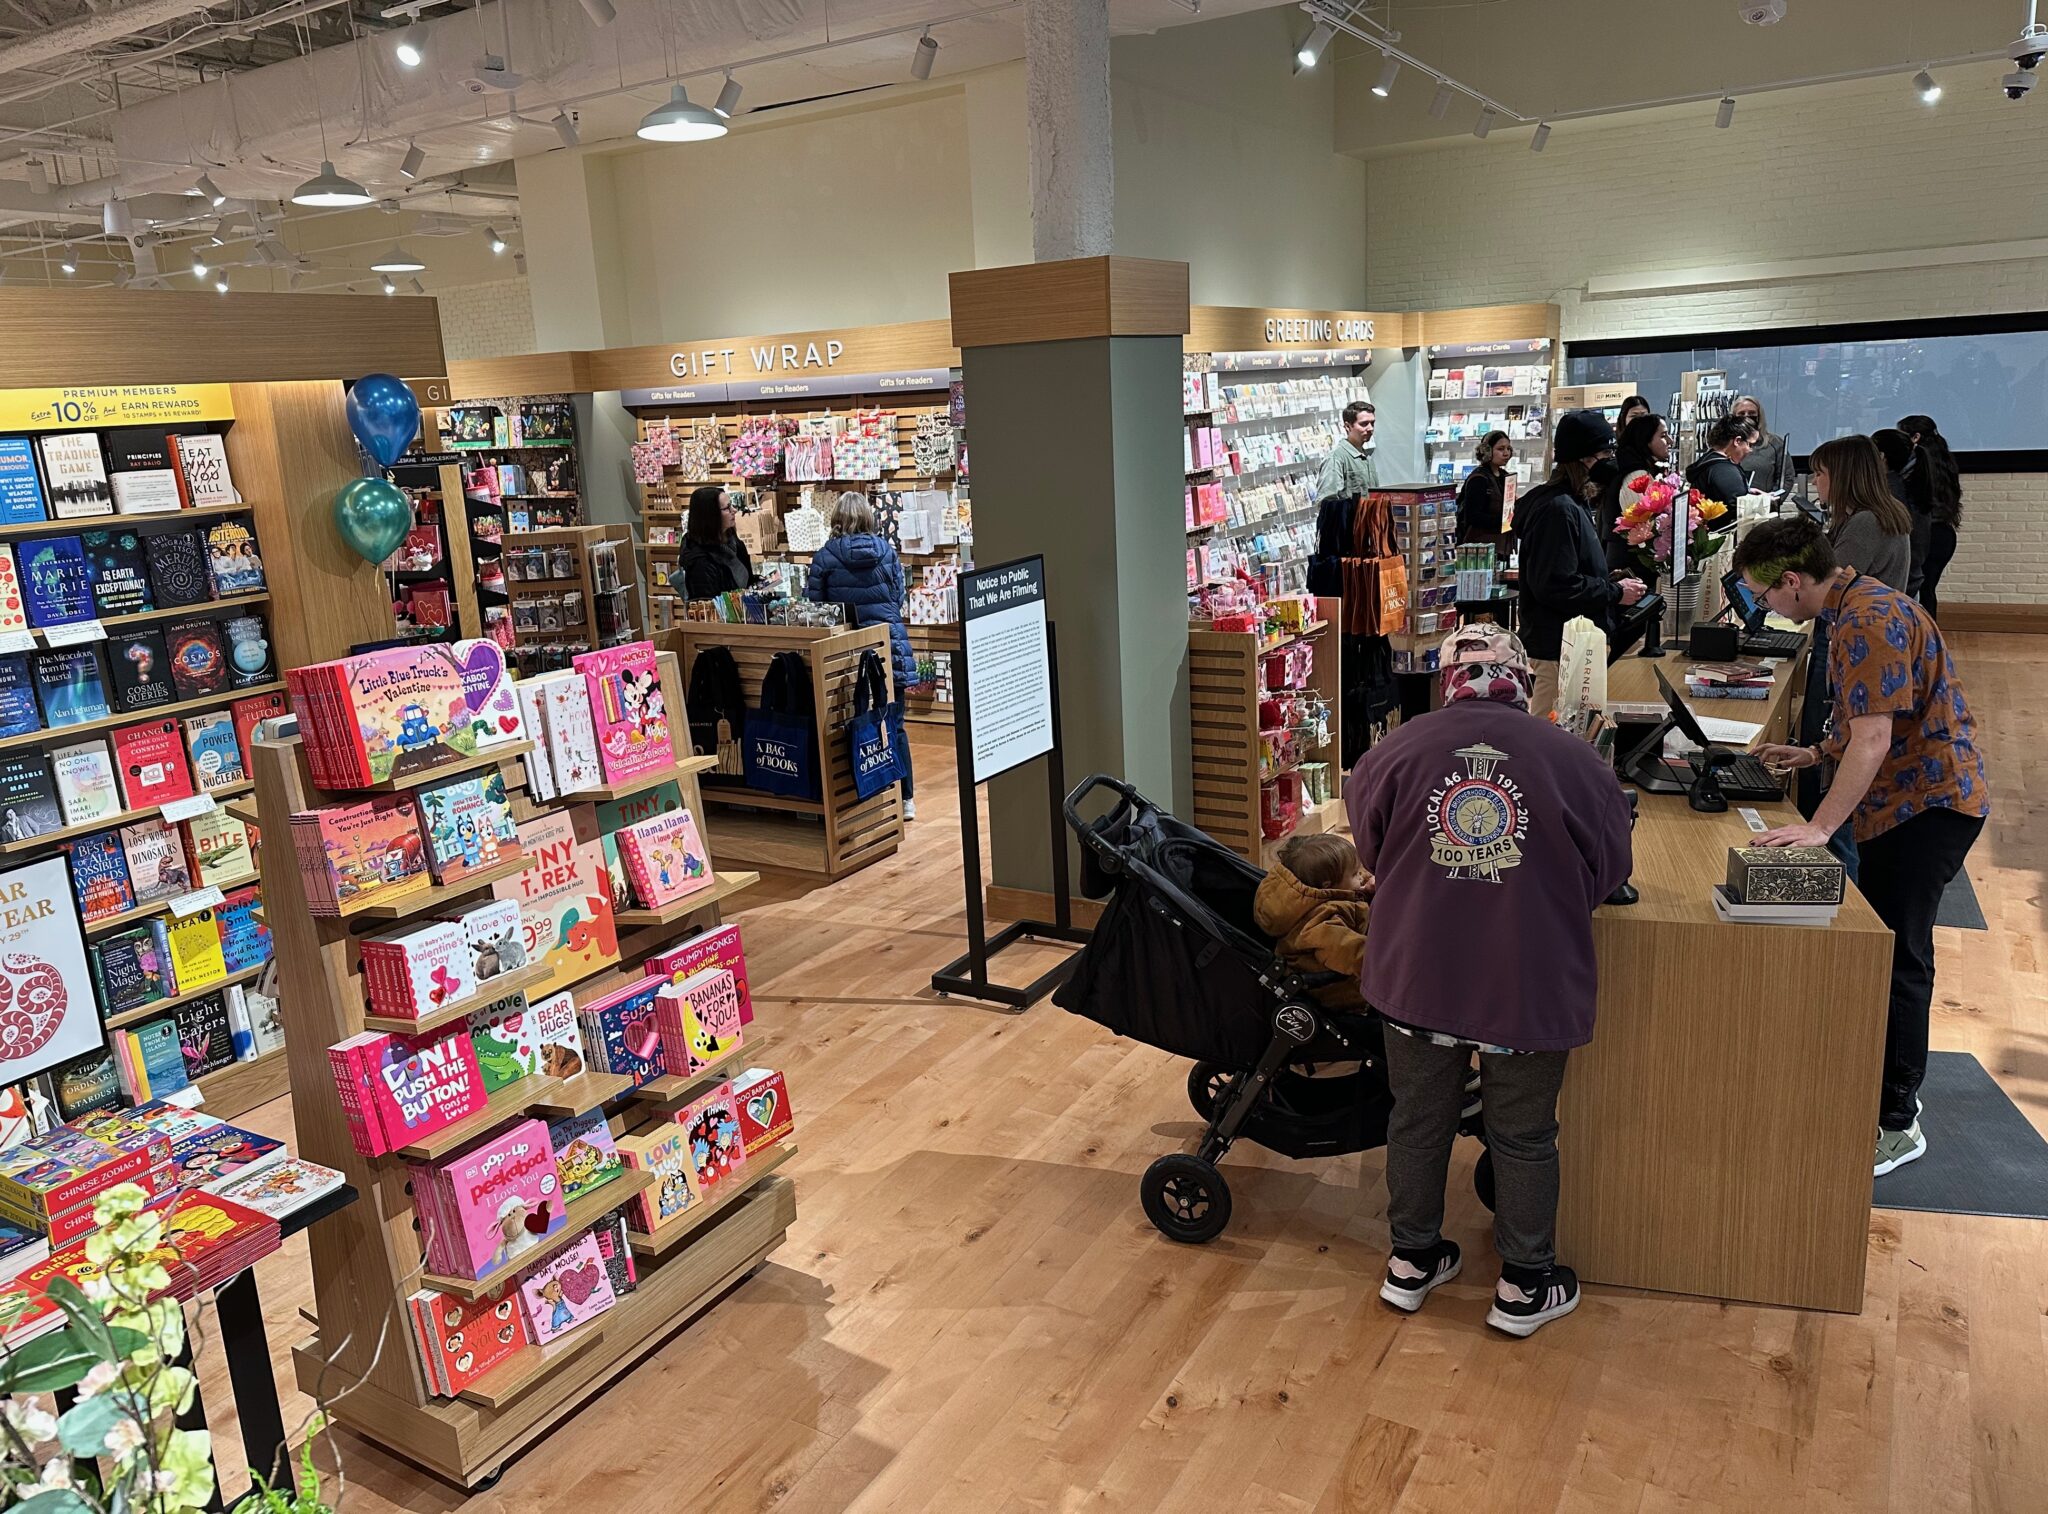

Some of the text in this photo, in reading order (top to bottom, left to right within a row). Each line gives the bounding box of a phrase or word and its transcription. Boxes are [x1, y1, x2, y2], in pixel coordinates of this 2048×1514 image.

[1265, 318, 1375, 343] GREETING CARDS
[1466, 344, 1511, 354] Greeting Cards
[670, 340, 843, 377] GIFT WRAP
[760, 383, 809, 395] Gifts for Readers
[880, 375, 933, 387] Gifts for Readers
[63, 386, 177, 398] PREMIUM MEMBERS
[651, 390, 696, 400] Gifts Readers
[31, 409, 52, 420] Extra
[121, 402, 149, 410] EARN
[152, 399, 200, 409] REWARDS
[84, 414, 99, 422] OFF
[60, 437, 83, 448] THE
[47, 448, 100, 462] TRADING
[126, 453, 162, 461] PRINCIPLES
[188, 447, 212, 458] EAT
[60, 462, 94, 475] GAME
[186, 458, 222, 470] WHAT
[191, 471, 220, 482] YOU
[193, 483, 223, 494] KILL
[31, 565, 85, 582] MARIE
[103, 567, 135, 581] IS EARTH
[976, 568, 1030, 592] Notice to Public
[34, 580, 89, 596] CURIE
[95, 578, 146, 595] EXCEPTIONAL?
[969, 581, 1038, 610] That We Are Filming
[54, 650, 93, 663] Miraculous
[174, 649, 221, 665] COSMOS
[621, 649, 651, 664] MICKEY
[358, 663, 449, 694] Little Blue Truck's
[126, 689, 169, 704] QUERIES
[127, 682, 165, 696] COSMIC
[383, 682, 431, 703] Valentine
[243, 706, 280, 722] TUTOR
[190, 718, 208, 731] THE
[202, 732, 236, 748] POWER
[130, 742, 170, 756] CONSTANT
[756, 742, 785, 757] A BAG
[59, 756, 90, 768] NO ONE
[756, 755, 799, 773] of BOOKS
[867, 748, 893, 769] BOOKS
[6, 764, 24, 772] THE
[61, 765, 90, 777] KNOWS
[9, 783, 30, 792] MAN
[202, 771, 242, 788] NUCLEAR
[68, 797, 88, 806] SARA
[451, 799, 486, 815] ROMANCE
[618, 794, 661, 822] TINY
[1427, 772, 1529, 840] LOCAL 46 1914-2014
[71, 811, 101, 823] WALKER
[328, 808, 375, 826] Construction
[337, 812, 394, 833] You're Just Right
[636, 814, 691, 840] llama llama
[128, 829, 173, 848] LOST WORLD
[200, 831, 243, 853] BITE
[78, 842, 106, 858] BEST
[131, 842, 178, 865] DINOSAURS
[1437, 839, 1512, 862] 100 YEARS
[73, 857, 123, 877] POSSIBLE
[75, 868, 125, 890] WORLDS
[521, 861, 579, 897] T. REX
[538, 885, 572, 901] IMPOSSIBLE
[166, 915, 201, 933] BREAT
[226, 913, 251, 927] Smil
[477, 912, 519, 934] Love You
[228, 938, 245, 947] How
[423, 930, 455, 949] Baby's First
[223, 940, 268, 959] World Really
[411, 937, 465, 964] Valentine's
[670, 932, 738, 971] GRUMPY MONKEY
[235, 953, 259, 965] Works
[429, 953, 450, 968] Day
[686, 952, 719, 978] VALENTINE
[107, 963, 138, 978] Night
[110, 972, 143, 990] Magic
[689, 973, 733, 1010] BANANAS
[178, 1003, 220, 1025] Light
[538, 999, 569, 1025] BEAR
[706, 998, 726, 1019] FOR
[710, 1000, 736, 1033] YOU!
[178, 1016, 226, 1041] Eaters
[540, 1010, 573, 1038] HUGS!
[78, 1062, 99, 1075] THIS
[66, 1072, 113, 1094] ORDINARY
[392, 1072, 438, 1106] PUSH
[438, 1057, 467, 1080] THE
[69, 1086, 117, 1109] STARDUST
[401, 1072, 471, 1122] BUTTON!
[439, 1093, 471, 1113] Tons of
[572, 1117, 598, 1130] Diggers
[684, 1099, 731, 1133] LOVEY THINGS
[644, 1134, 682, 1167] LOVE
[58, 1159, 135, 1201] CHINESE ZODIAC
[470, 1146, 548, 1206] peekaboo!
[493, 1172, 539, 1204] Love You
[554, 1251, 580, 1268] MOUSE!
